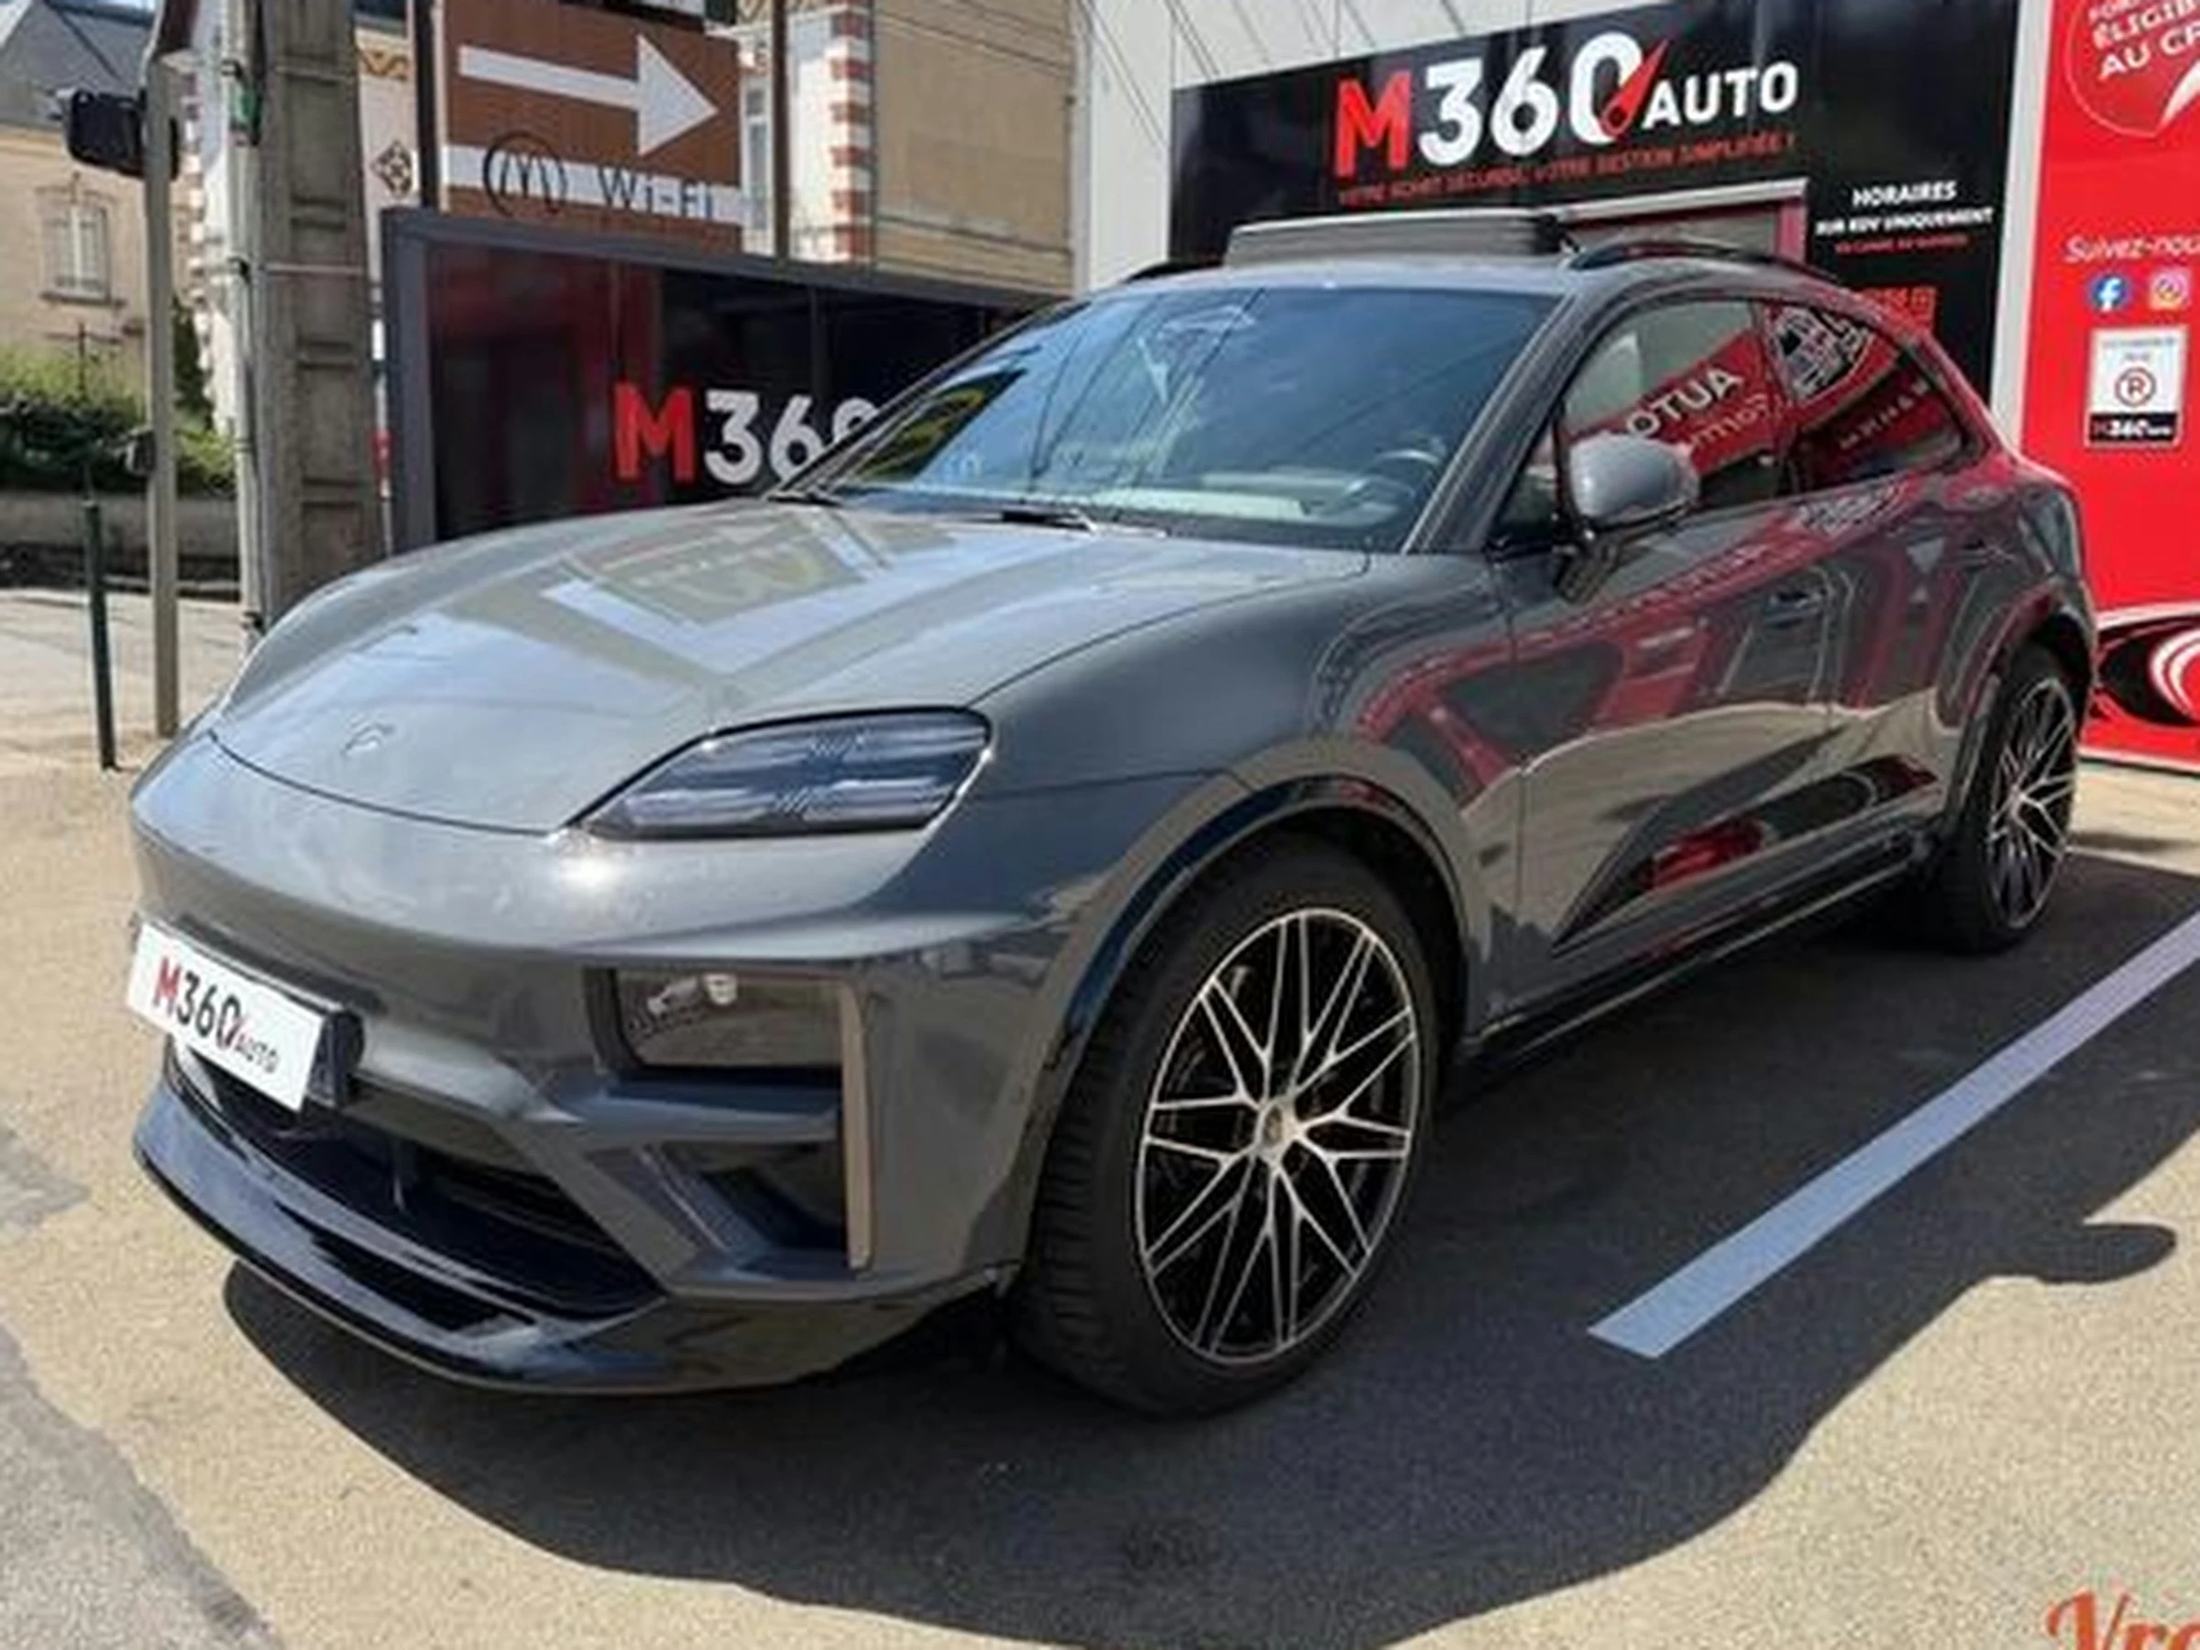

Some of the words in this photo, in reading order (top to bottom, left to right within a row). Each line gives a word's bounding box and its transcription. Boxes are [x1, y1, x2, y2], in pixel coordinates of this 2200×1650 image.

[2098, 41, 2152, 80] AU
[1332, 31, 1646, 178] M360
[1642, 62, 1798, 130] AUTO
[1852, 181, 1957, 207] HORAIRES
[2064, 234, 2200, 263] Suivez-nou
[152, 956, 244, 1051] M360
